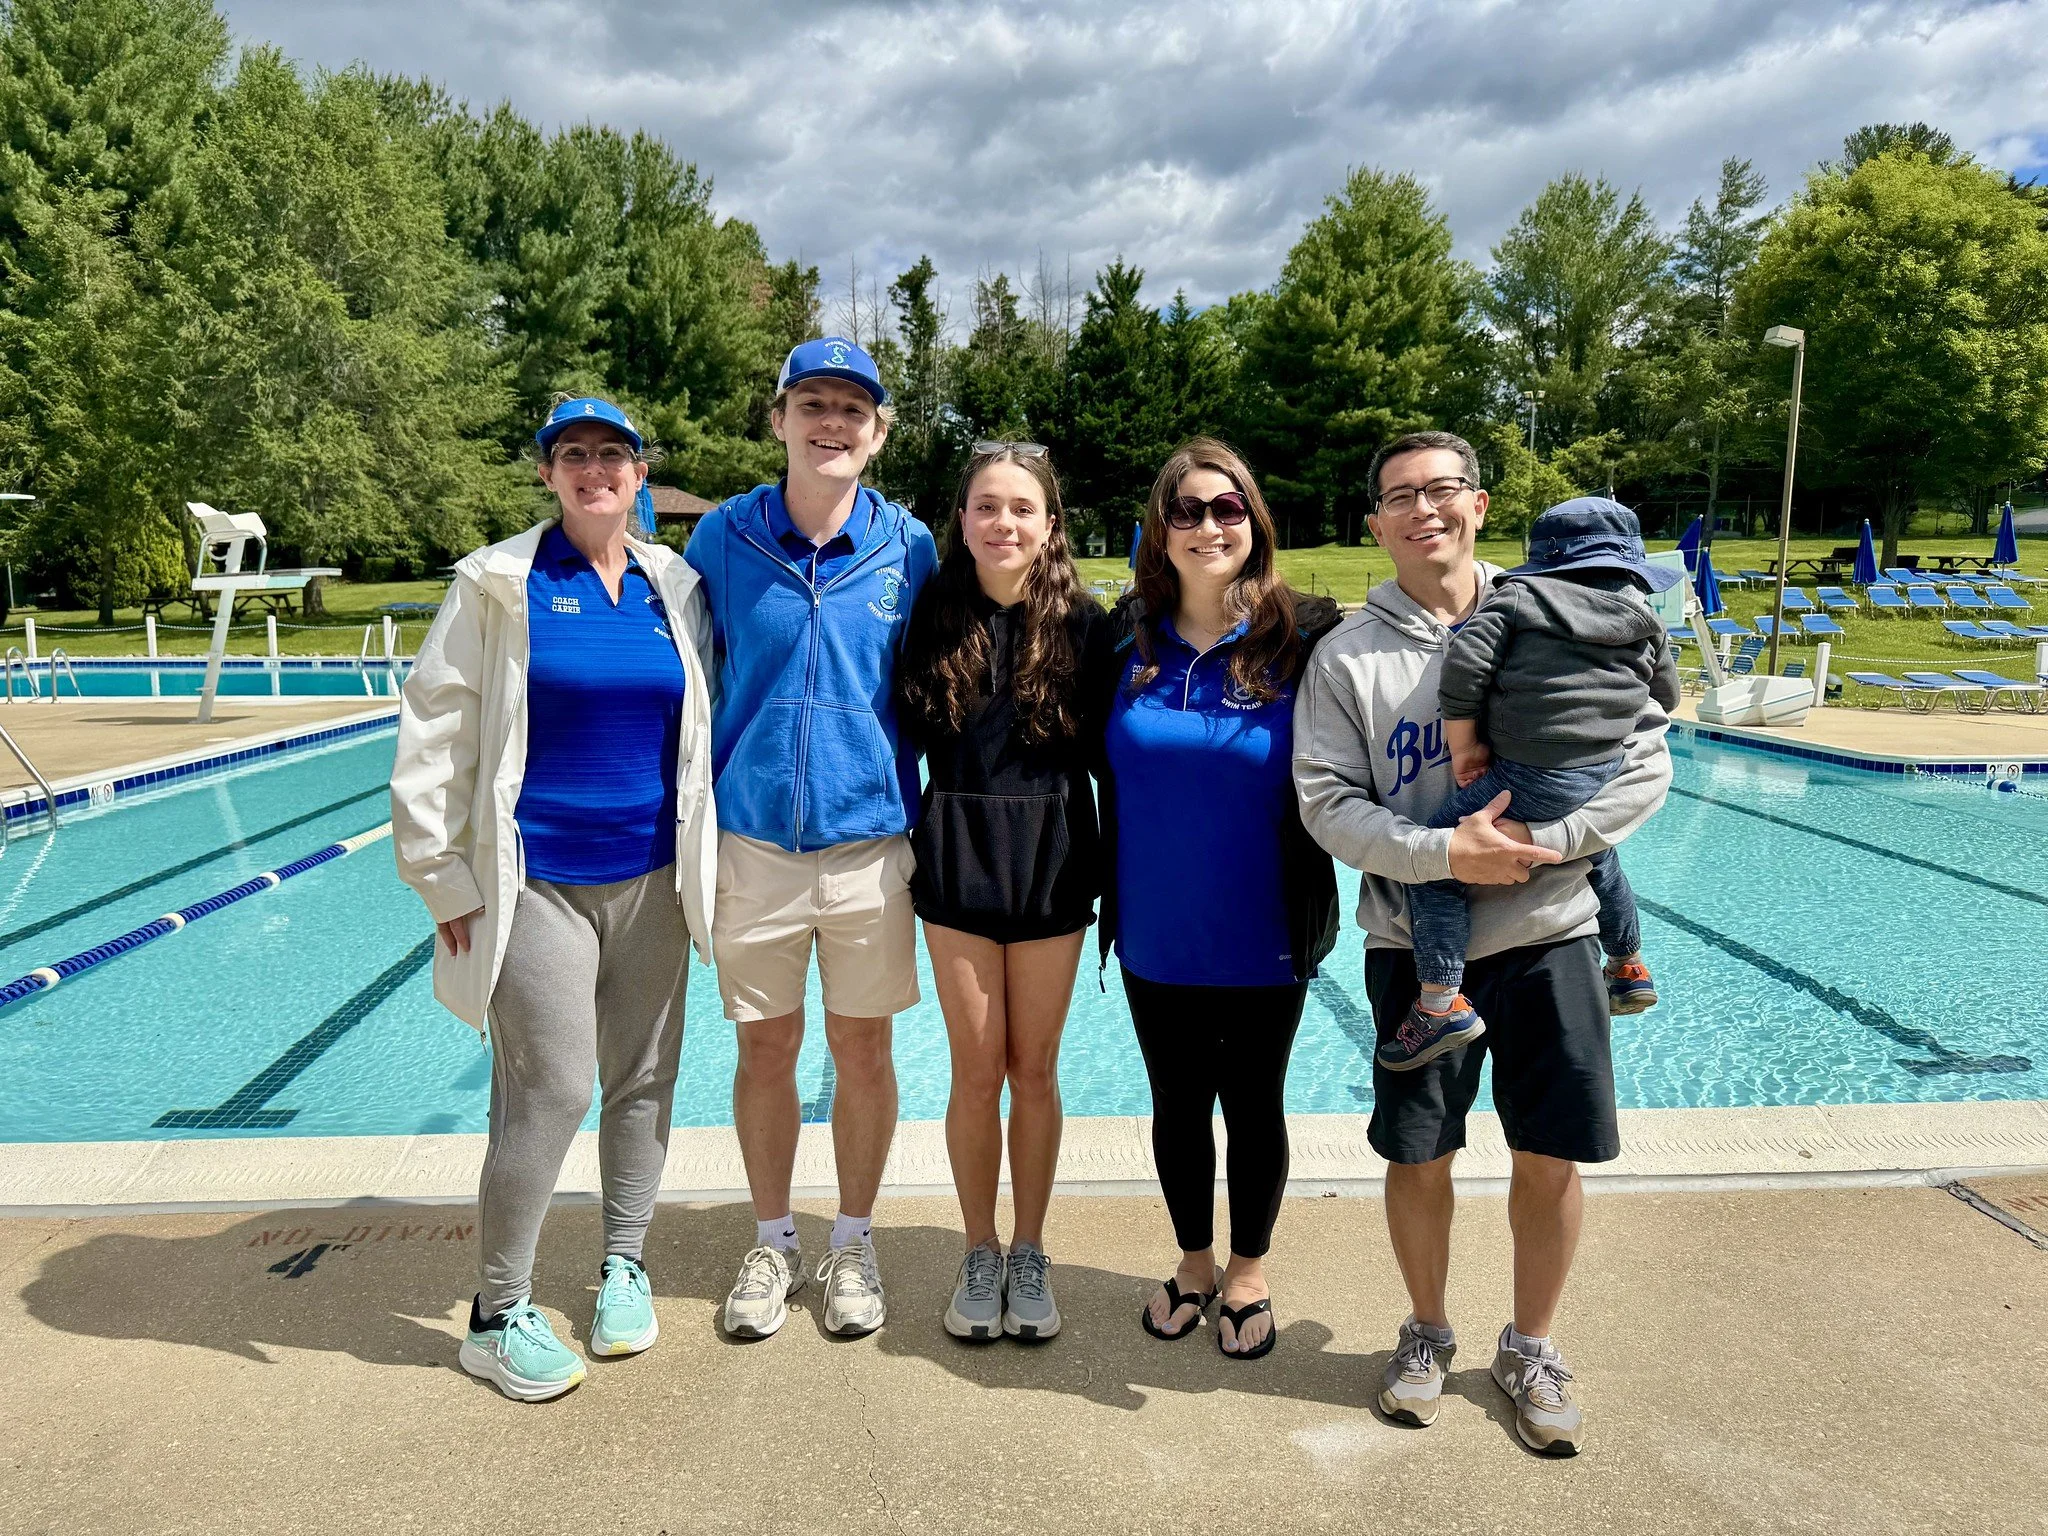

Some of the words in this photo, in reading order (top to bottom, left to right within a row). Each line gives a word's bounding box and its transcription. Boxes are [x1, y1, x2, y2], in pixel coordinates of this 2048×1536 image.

[875, 566, 910, 588] STONEGATE
[552, 596, 580, 605] COACH
[552, 604, 581, 614] CARRIE
[867, 601, 884, 618] SWIM
[884, 613, 902, 621] TEAM
[1220, 698, 1240, 710] SWIM
[1241, 701, 1263, 711] TEAM
[249, 1226, 314, 1247] NO
[342, 1225, 474, 1243] DIVIN
[267, 1243, 331, 1280] 4
